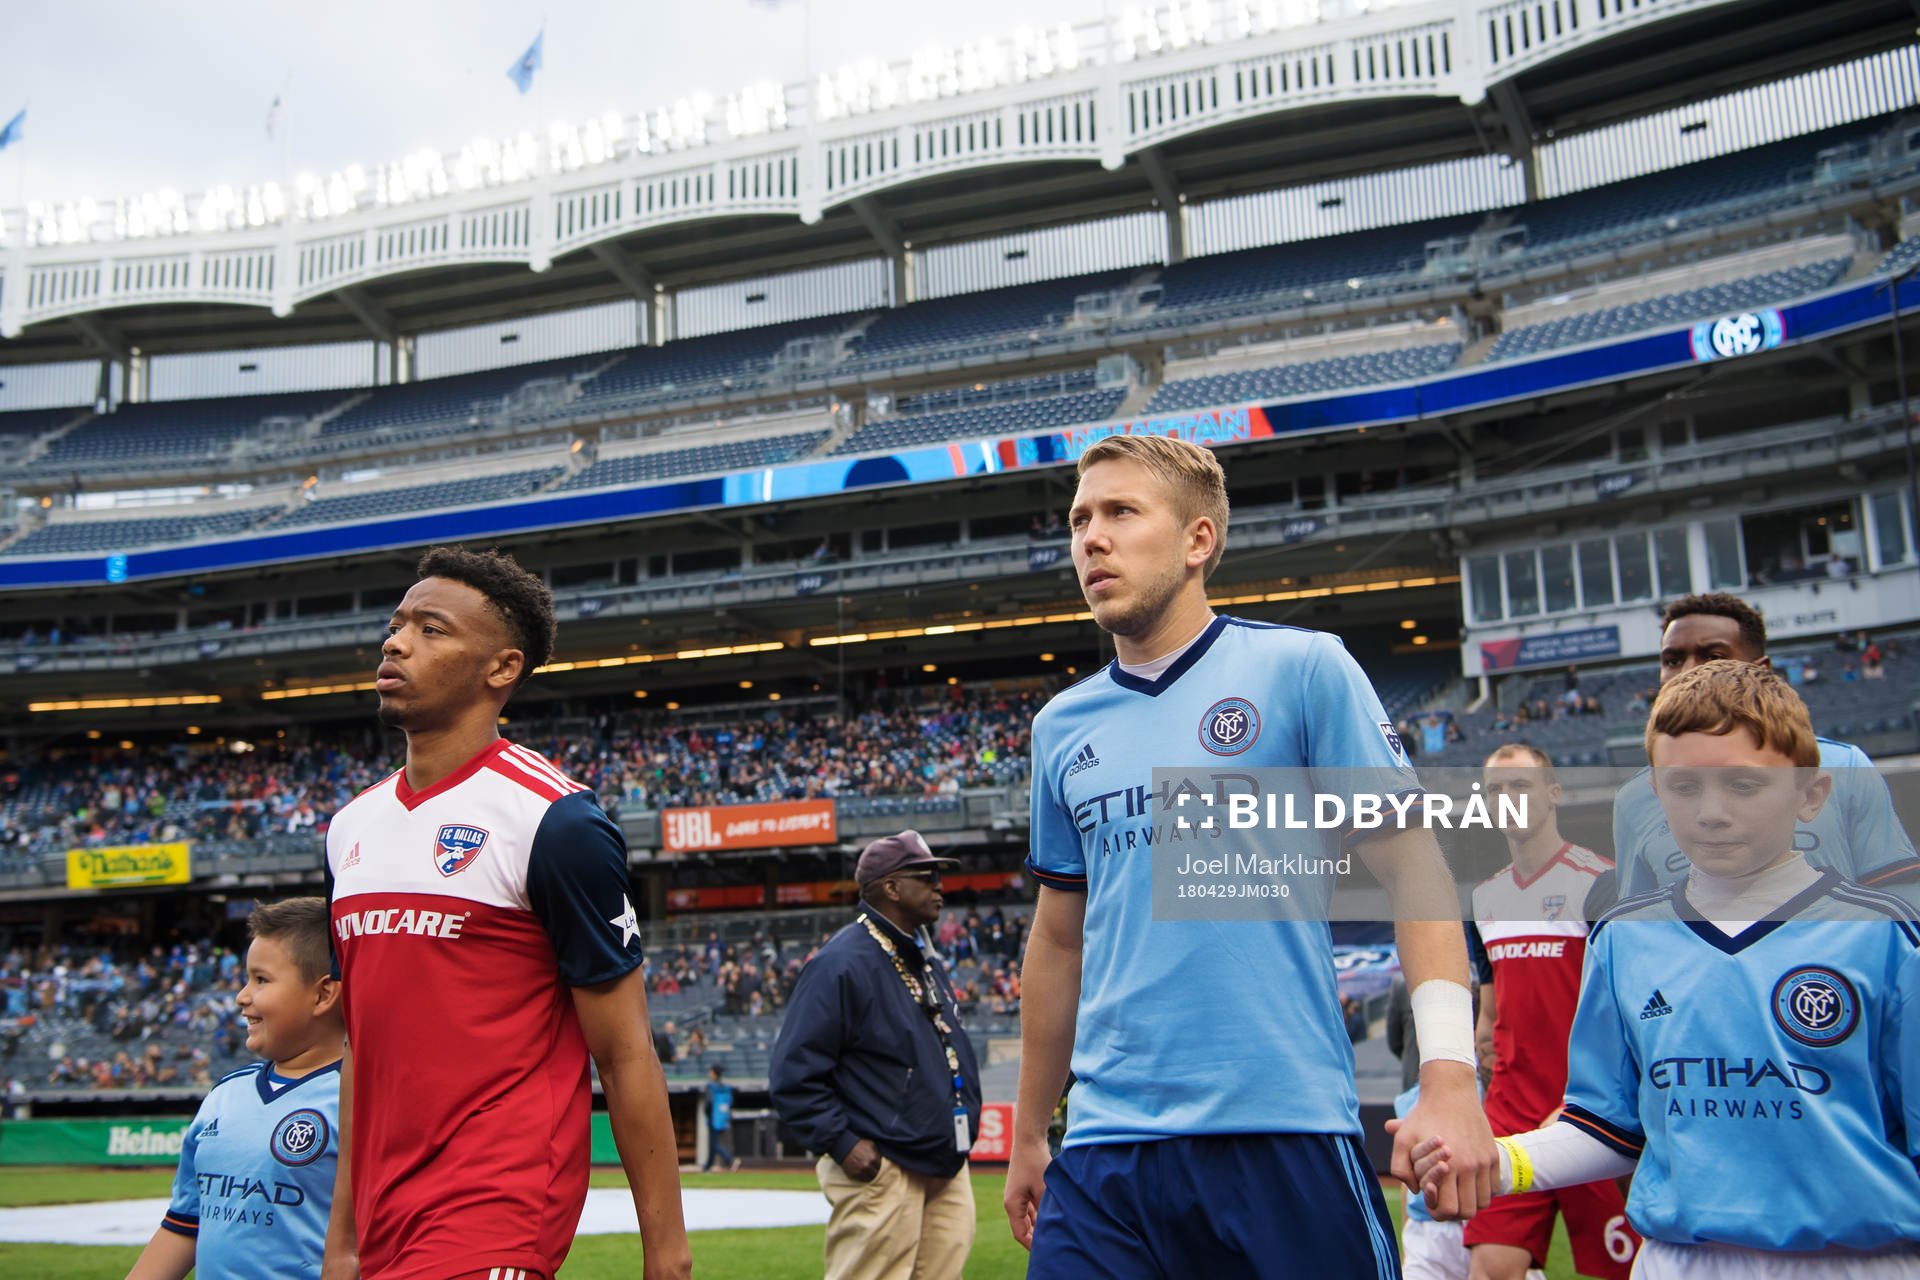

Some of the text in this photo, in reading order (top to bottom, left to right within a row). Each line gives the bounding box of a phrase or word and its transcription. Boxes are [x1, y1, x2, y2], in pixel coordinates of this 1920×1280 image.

[1069, 757, 1100, 777] adidas
[1074, 773, 1260, 834] ETIHAD
[440, 828, 484, 845] FC DALLAS
[1103, 818, 1223, 857] AIRWAYS
[1640, 1006, 1673, 1020] adidas
[1649, 1057, 1832, 1096] ETIHAD
[1668, 1098, 1804, 1121] AIRWAYS
[107, 1126, 187, 1156] Heine
[1604, 1215, 1635, 1263] 6
